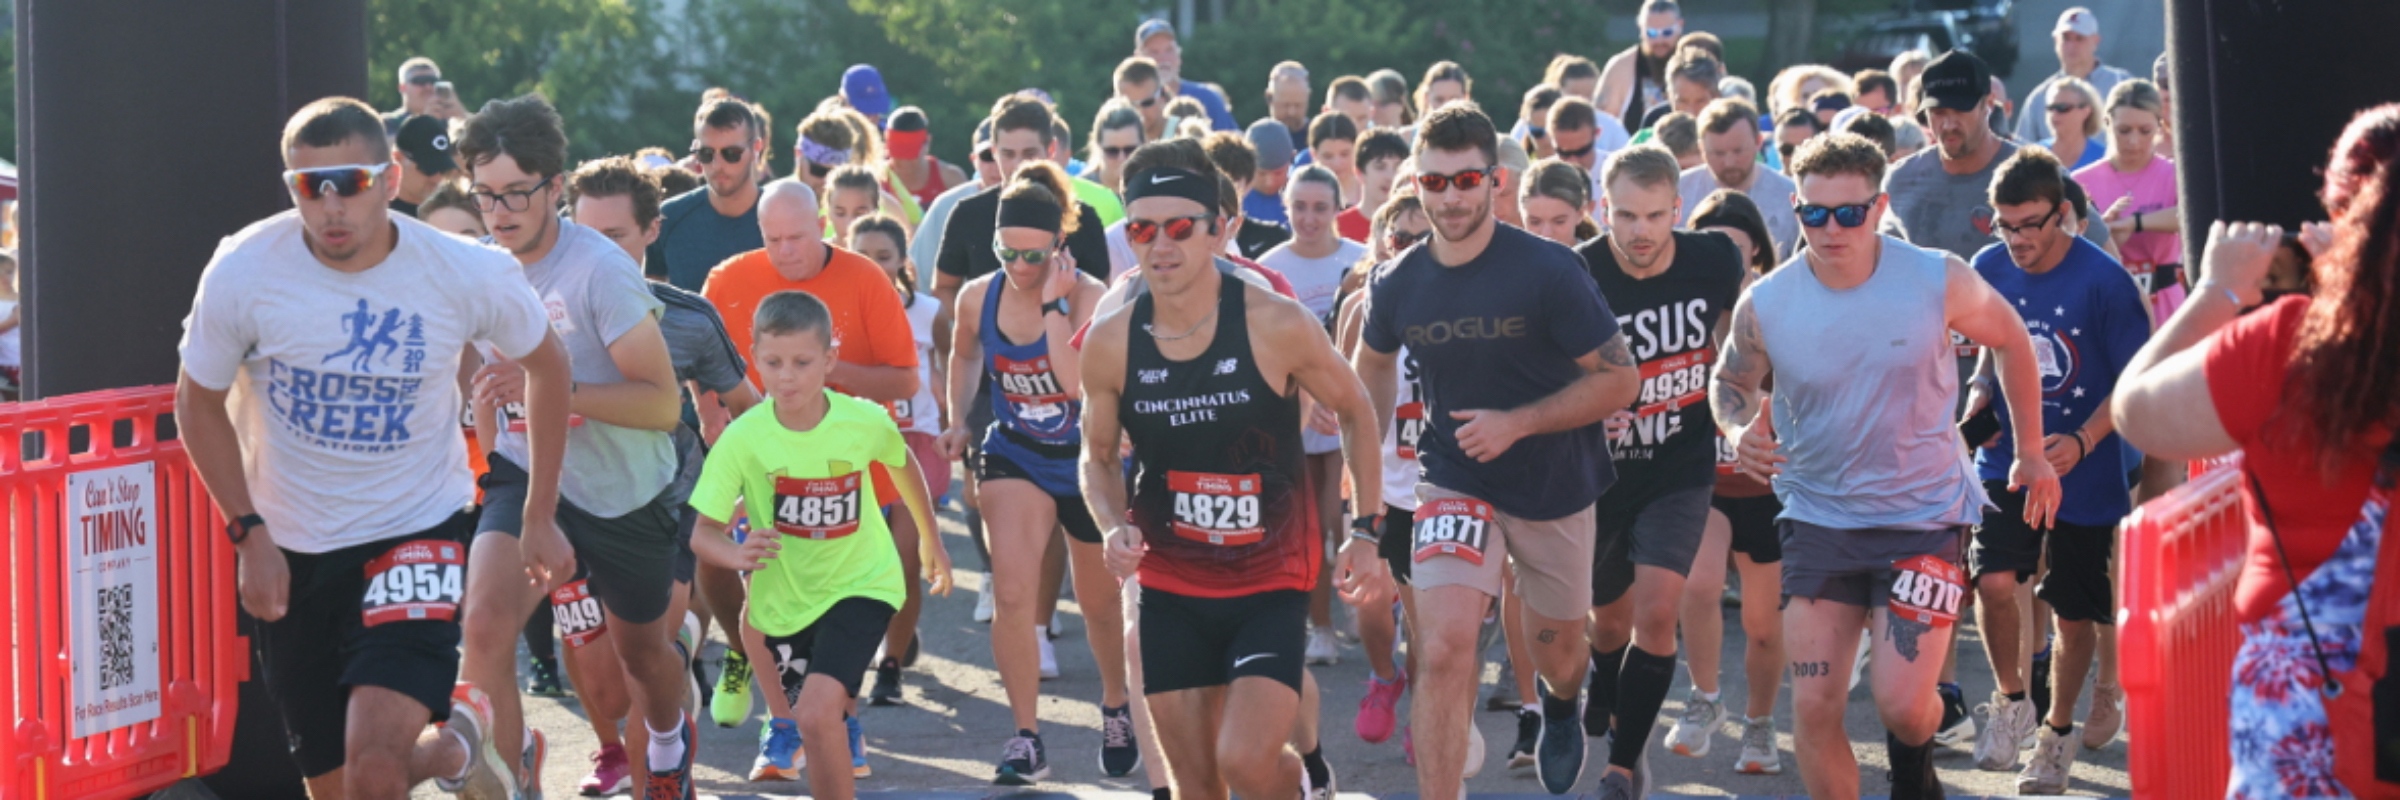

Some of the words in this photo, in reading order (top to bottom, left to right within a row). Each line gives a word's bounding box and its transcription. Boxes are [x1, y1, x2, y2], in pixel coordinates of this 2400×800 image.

[432, 134, 448, 150] C
[1404, 316, 1526, 347] ROGUE
[1617, 298, 1707, 360] ESUS
[402, 361, 420, 373] 21
[403, 349, 425, 361] 20
[1003, 371, 1058, 396] 4911
[1134, 388, 1251, 414] CINCINNATUS
[1640, 364, 1706, 404] 4938
[267, 381, 415, 442] CREEK
[1170, 409, 1218, 427] ELITE
[85, 478, 114, 509] Can't
[116, 475, 140, 509] Stop
[778, 491, 857, 527] 4851
[1173, 492, 1260, 529] 4829
[80, 507, 145, 556] TIMING
[1418, 514, 1484, 549] 4871
[364, 564, 463, 606] 4954
[1892, 569, 1963, 614] 4870
